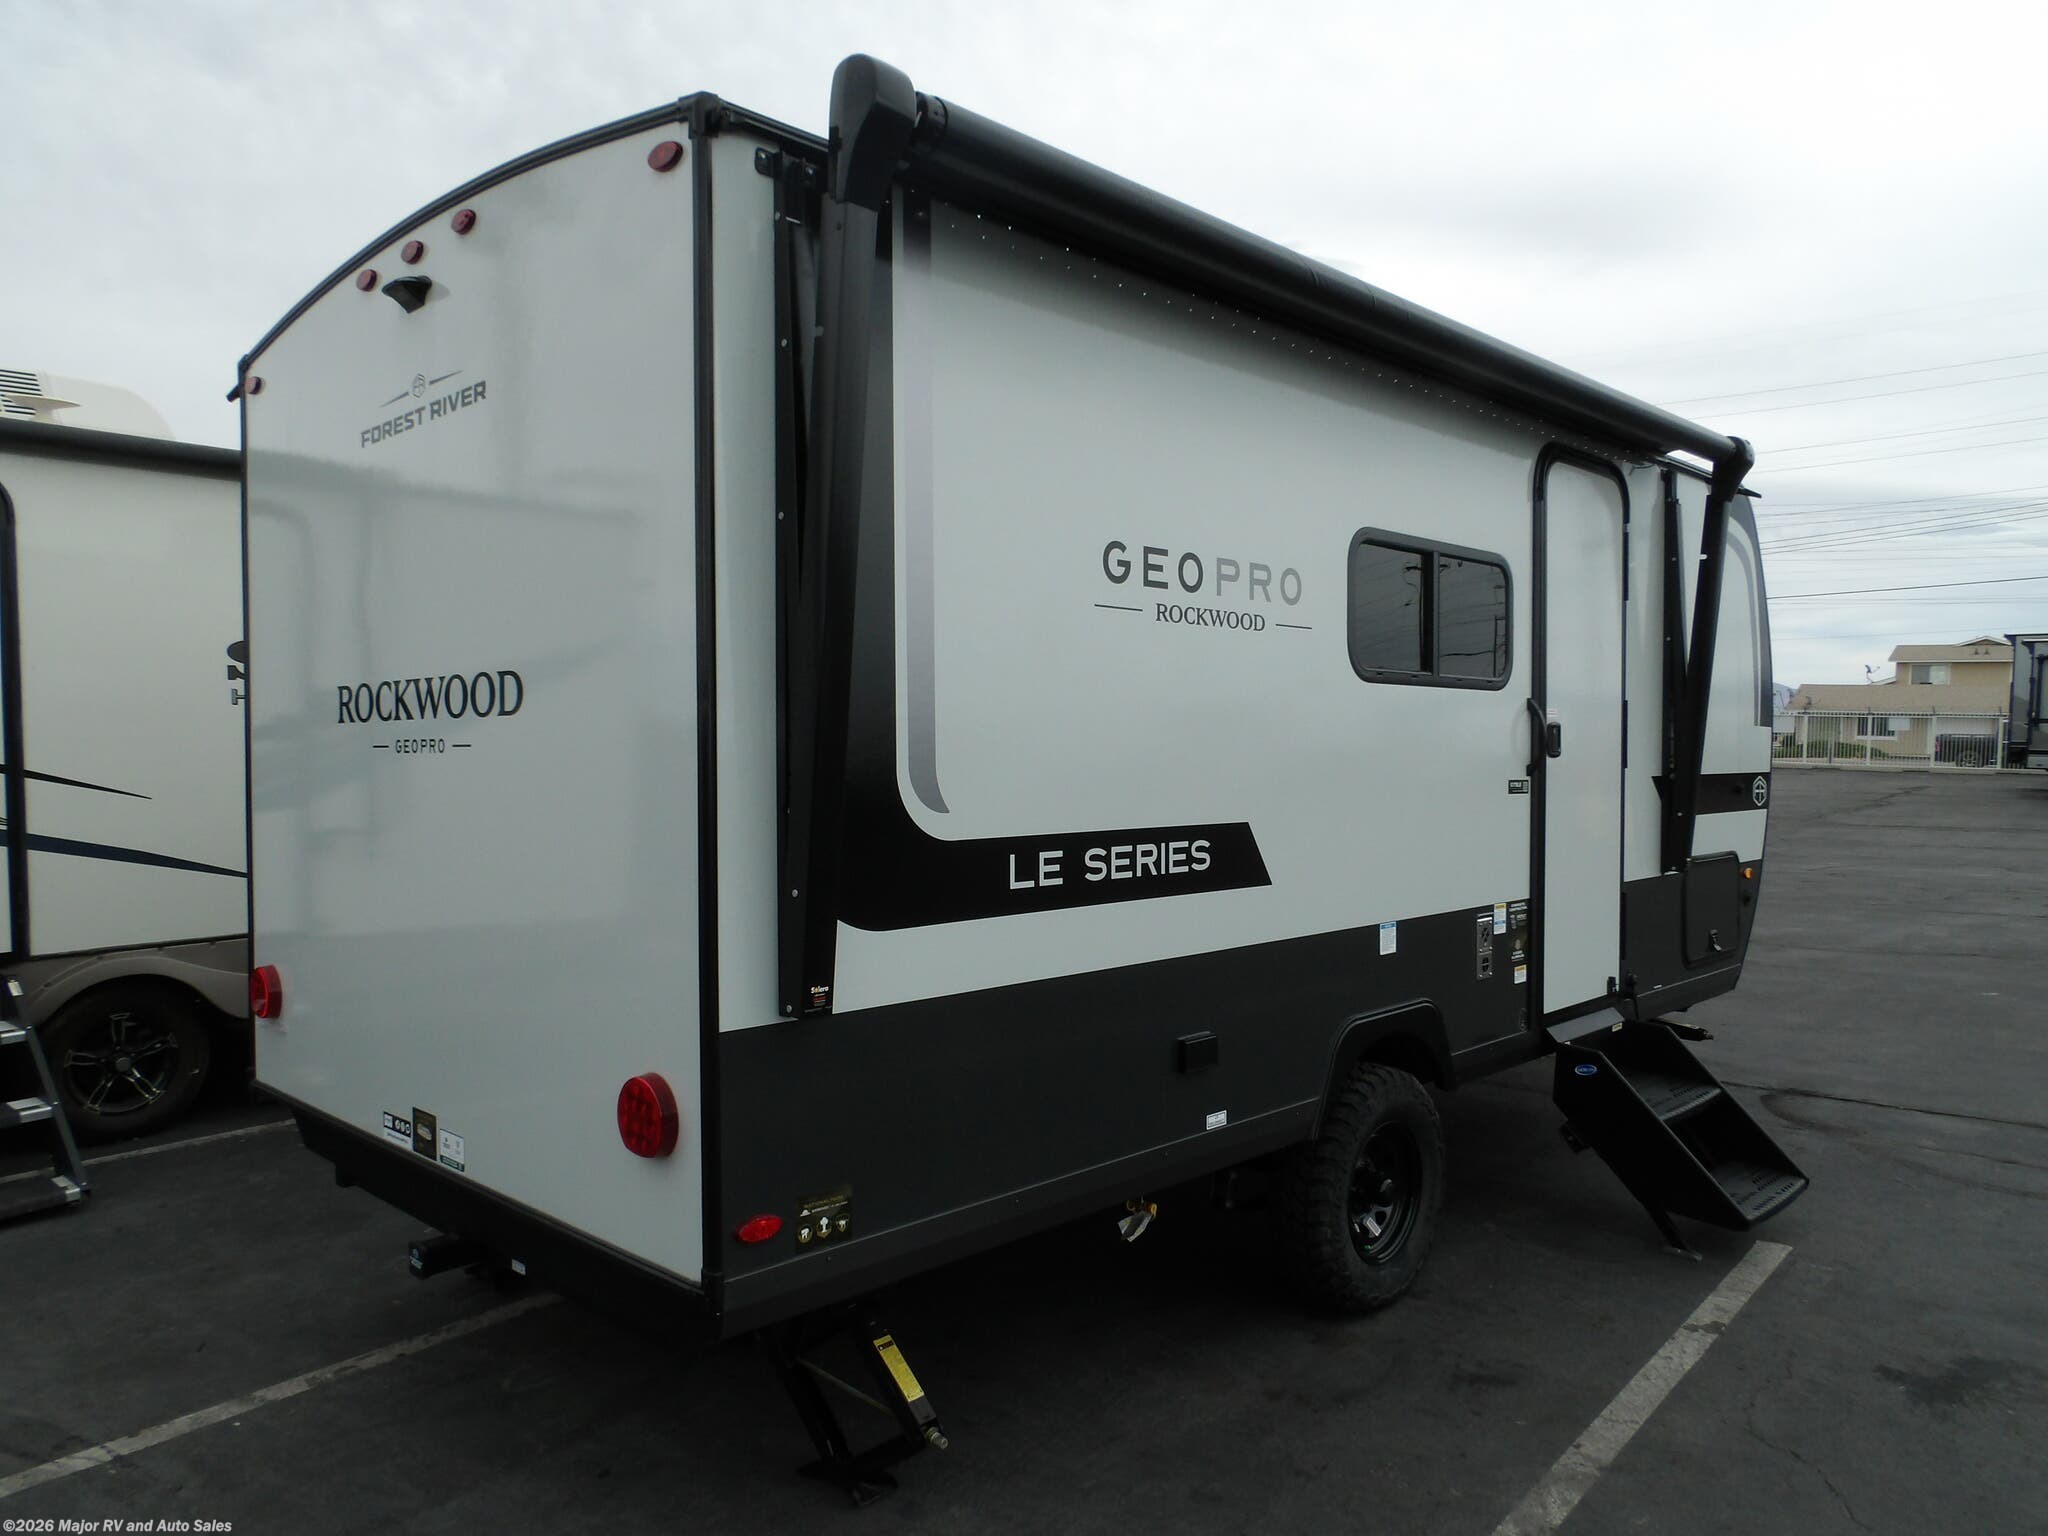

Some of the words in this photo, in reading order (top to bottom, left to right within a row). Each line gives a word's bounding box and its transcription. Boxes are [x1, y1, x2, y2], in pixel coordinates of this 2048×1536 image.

[360, 405, 427, 449] FOREST
[429, 379, 487, 421] RIVER
[1102, 540, 1303, 607] GEOPRO
[1155, 604, 1266, 632] ROCKWOOD
[337, 670, 524, 724] ROCKWOOD
[394, 738, 446, 754] GEOPRO
[1009, 850, 1064, 890] LE
[1084, 839, 1211, 882] SERIES
